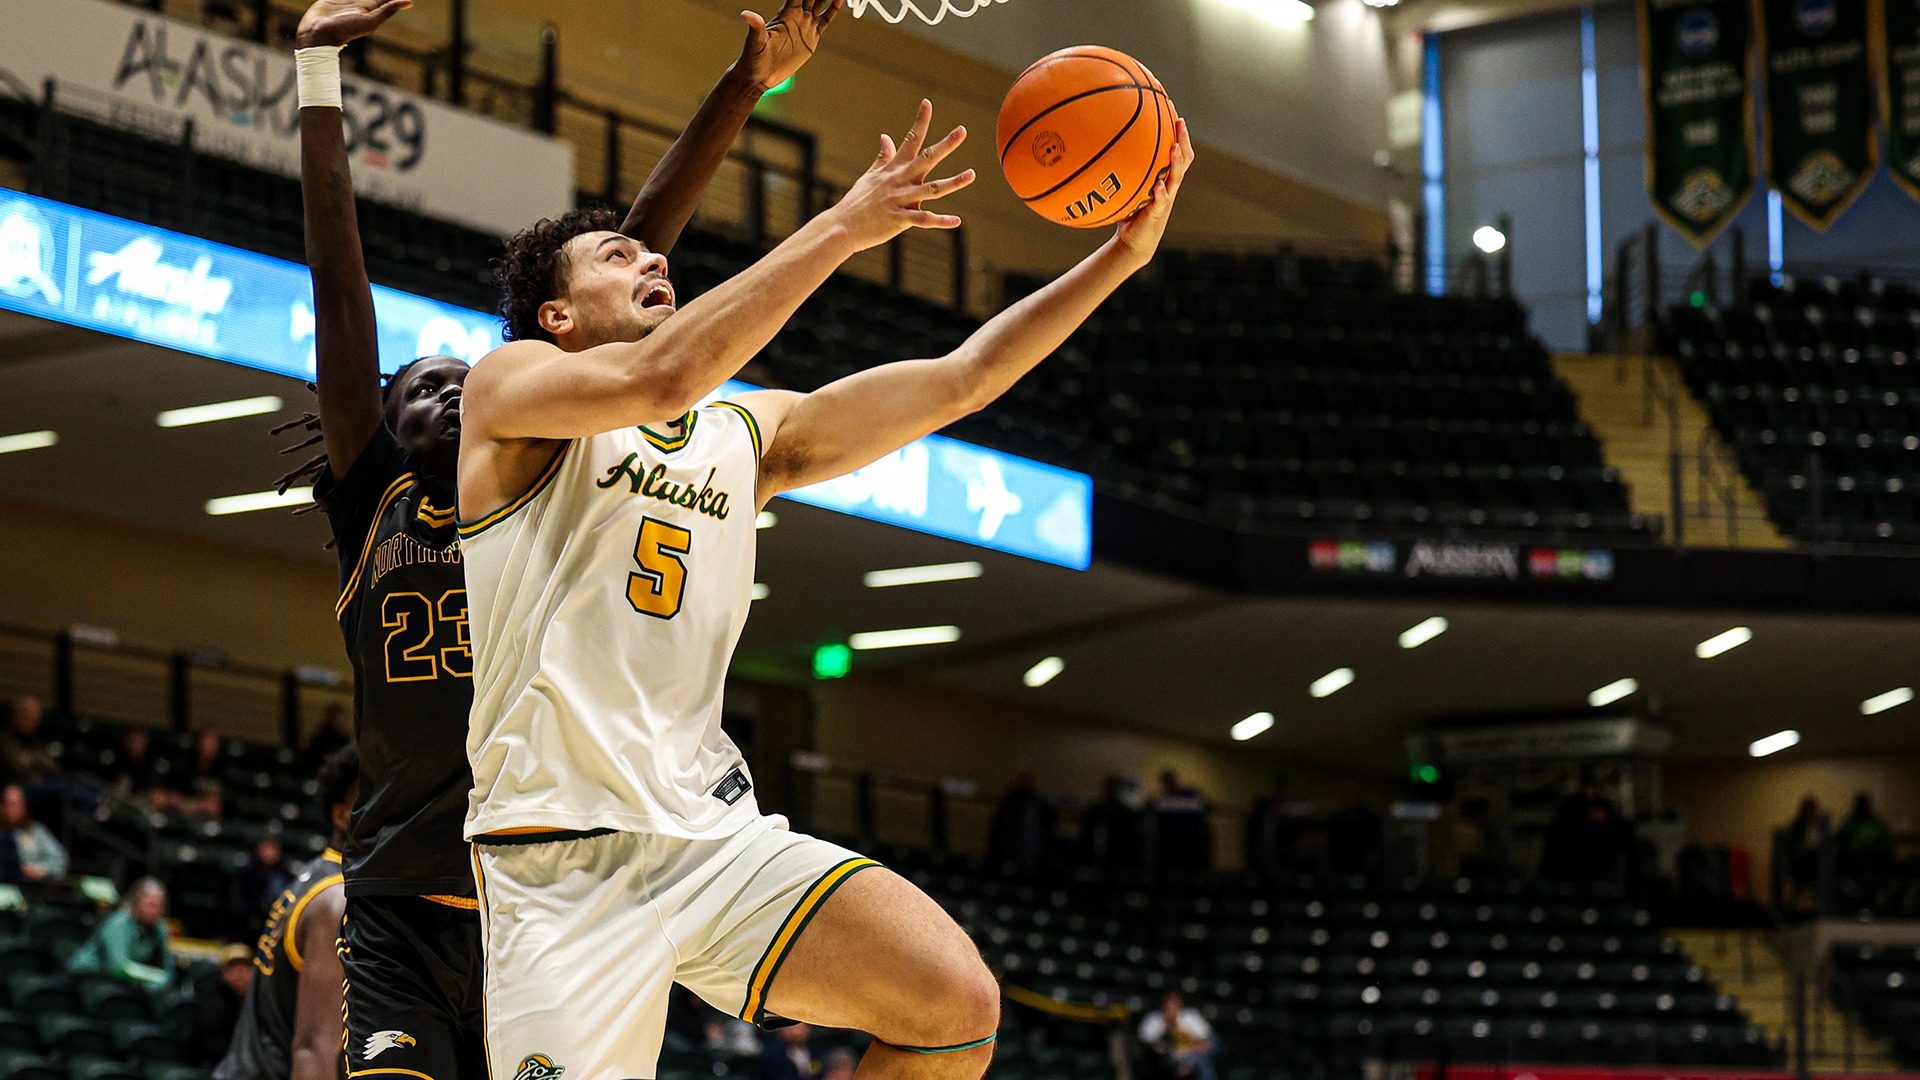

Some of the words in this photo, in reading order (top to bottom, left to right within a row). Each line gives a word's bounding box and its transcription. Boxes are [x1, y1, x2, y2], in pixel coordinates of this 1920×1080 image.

[1065, 171, 1122, 219] EVO
[596, 452, 730, 521] Alaska
[625, 514, 692, 621] 5
[381, 588, 475, 683] 23
